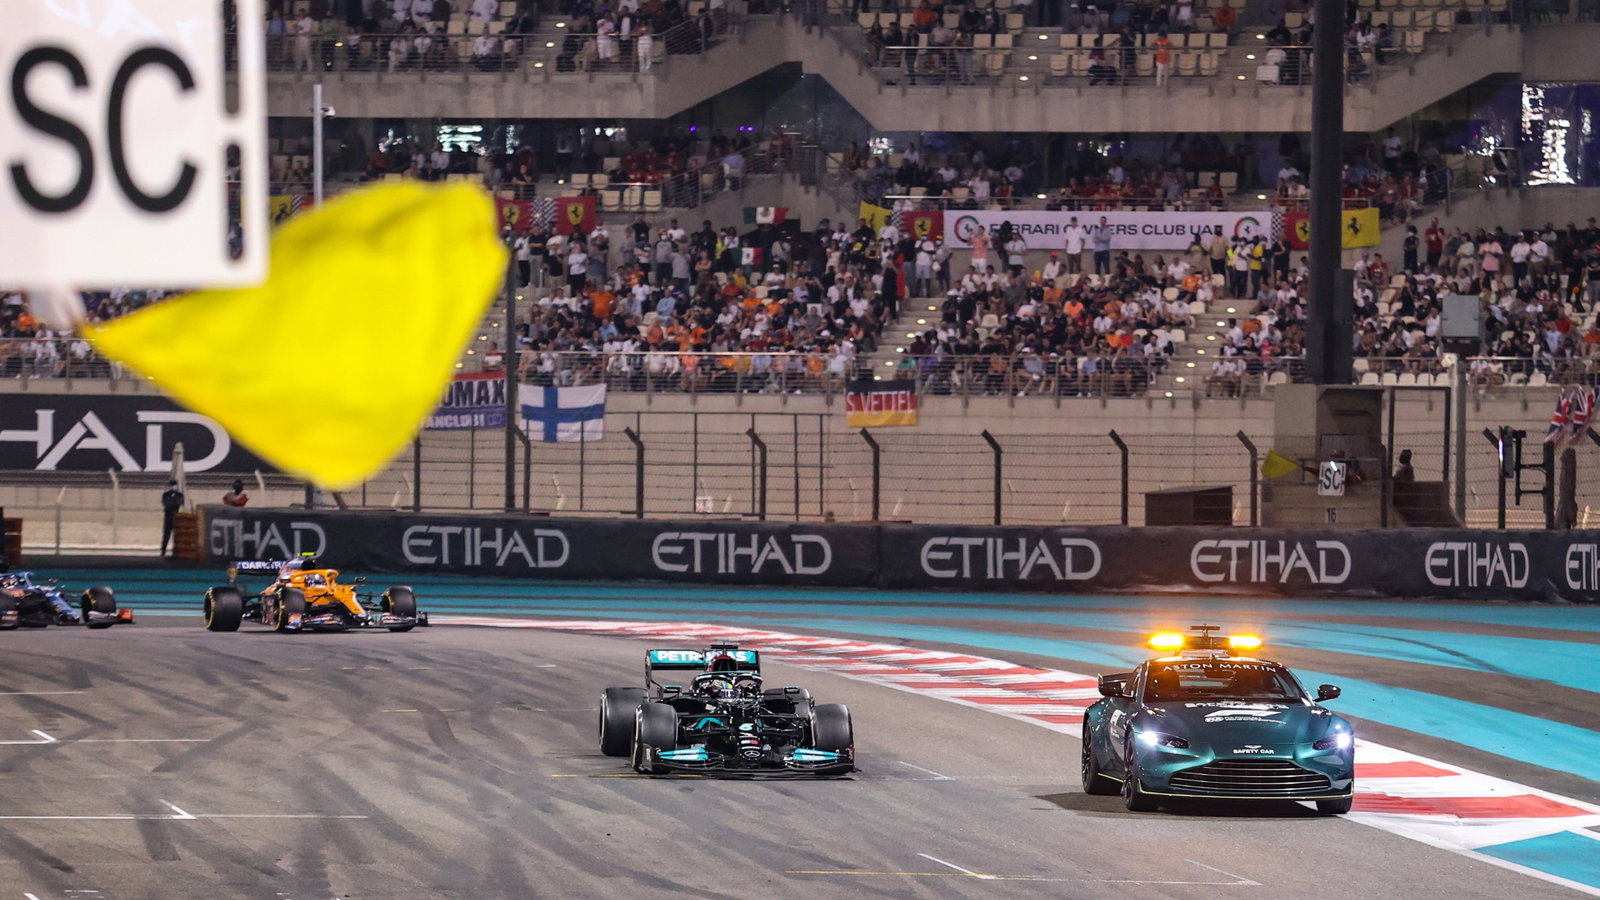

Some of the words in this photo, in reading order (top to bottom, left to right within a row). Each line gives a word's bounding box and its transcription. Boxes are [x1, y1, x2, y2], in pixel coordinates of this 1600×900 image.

[10, 45, 198, 214] SC
[989, 223, 1060, 235] FRRARI
[1142, 224, 1185, 235] CLUB
[860, 390, 913, 415] VETTEL
[1323, 468, 1341, 490] SC
[210, 518, 327, 562] ETIHAD
[402, 525, 570, 568] ETIHAD
[651, 531, 832, 575] ETIHAD
[921, 536, 1102, 581] ETIHAD
[1190, 539, 1352, 584] ETIHAD
[1424, 542, 1530, 589] ETIHAD
[1163, 663, 1212, 672] ASTON
[1219, 663, 1276, 673] MARTIN
